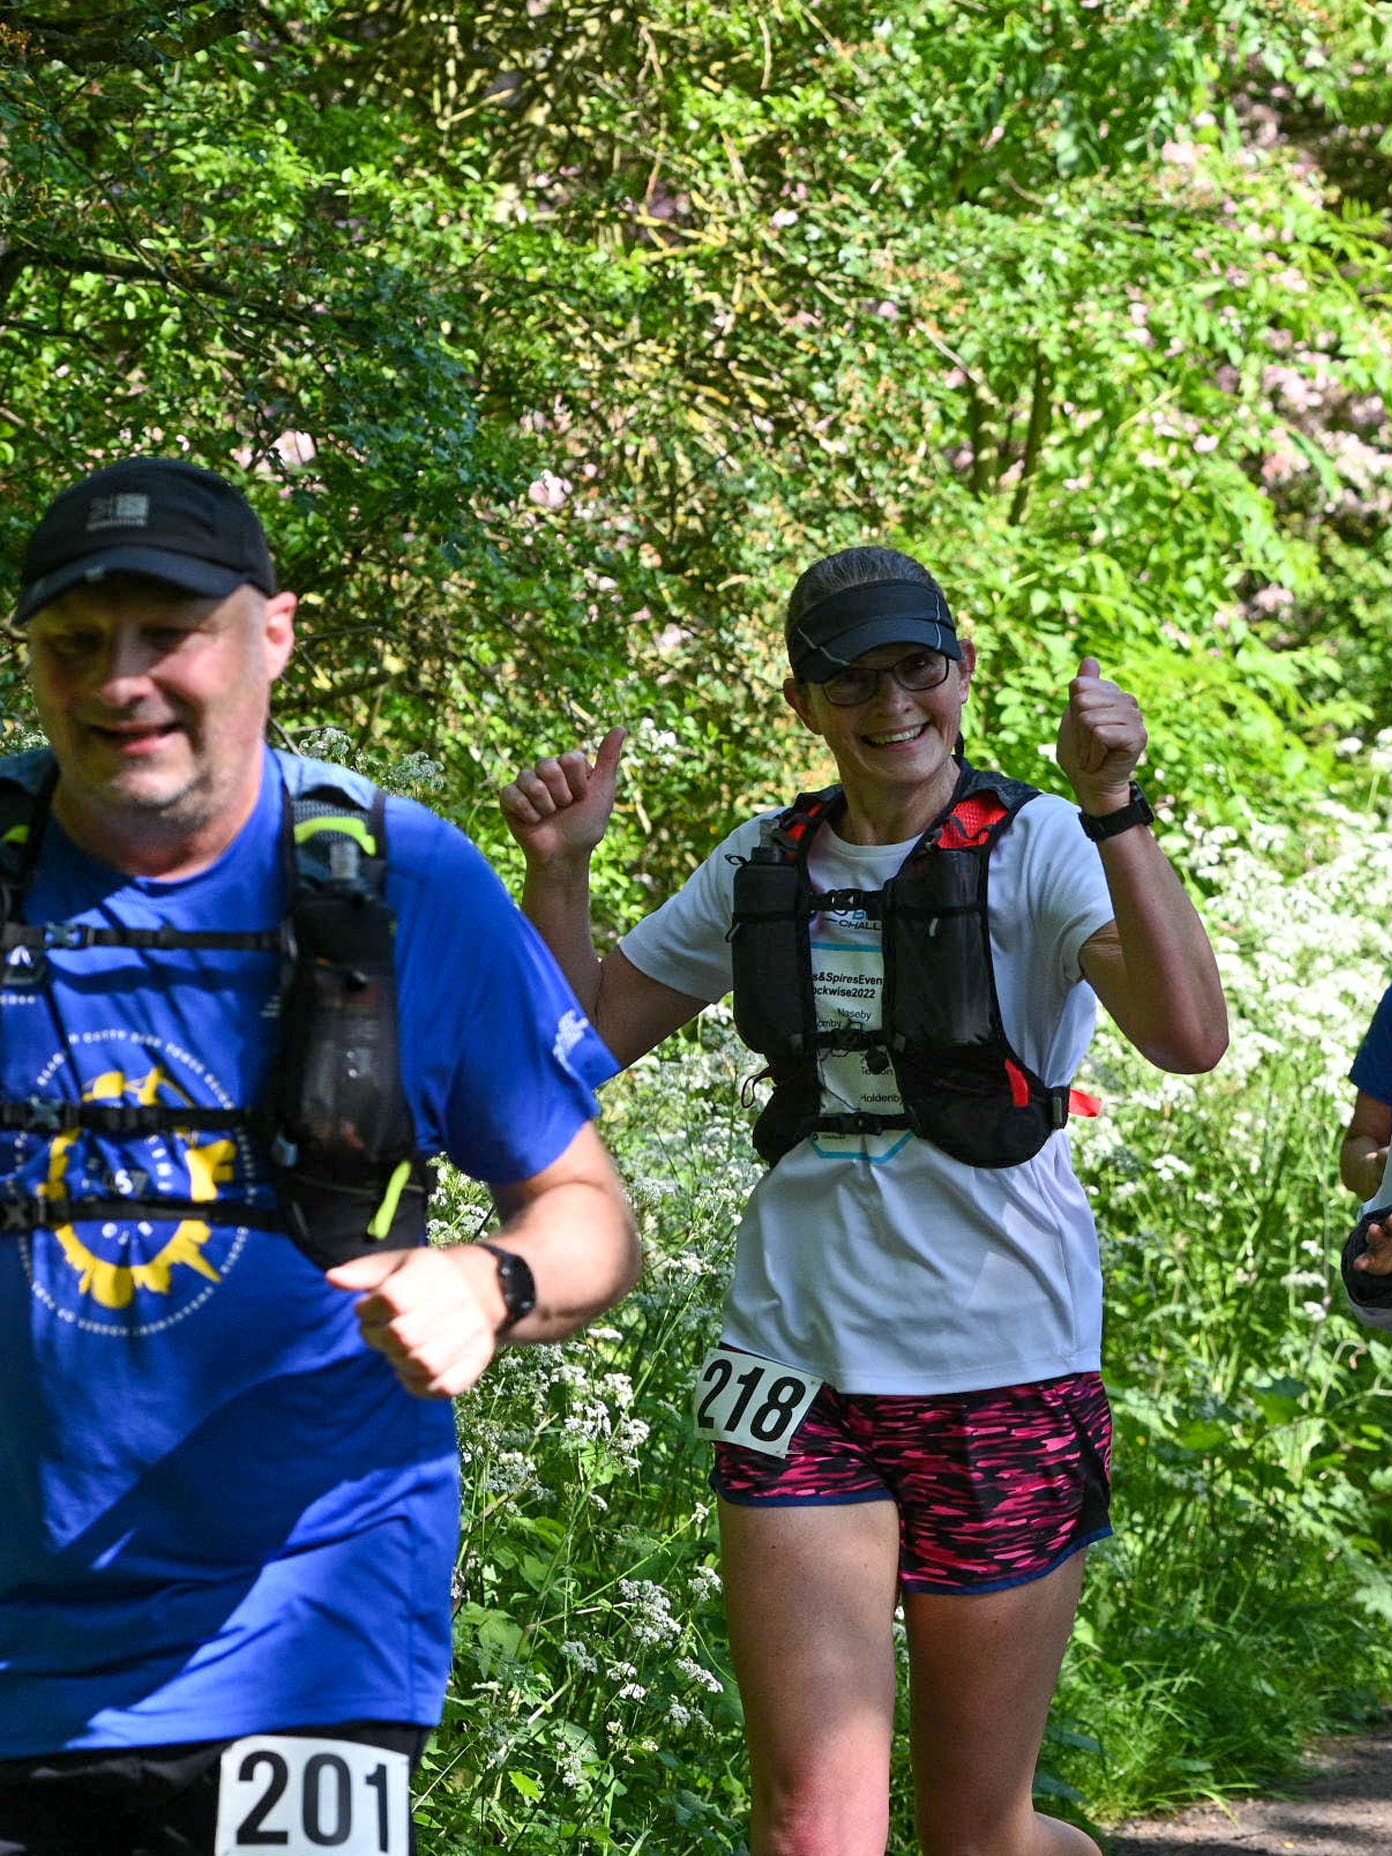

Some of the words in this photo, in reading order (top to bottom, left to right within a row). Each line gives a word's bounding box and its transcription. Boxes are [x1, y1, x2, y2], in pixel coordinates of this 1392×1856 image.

[837, 1008, 871, 1022] Naseby
[697, 1359, 806, 1442] 218
[237, 1750, 388, 1853] 201
